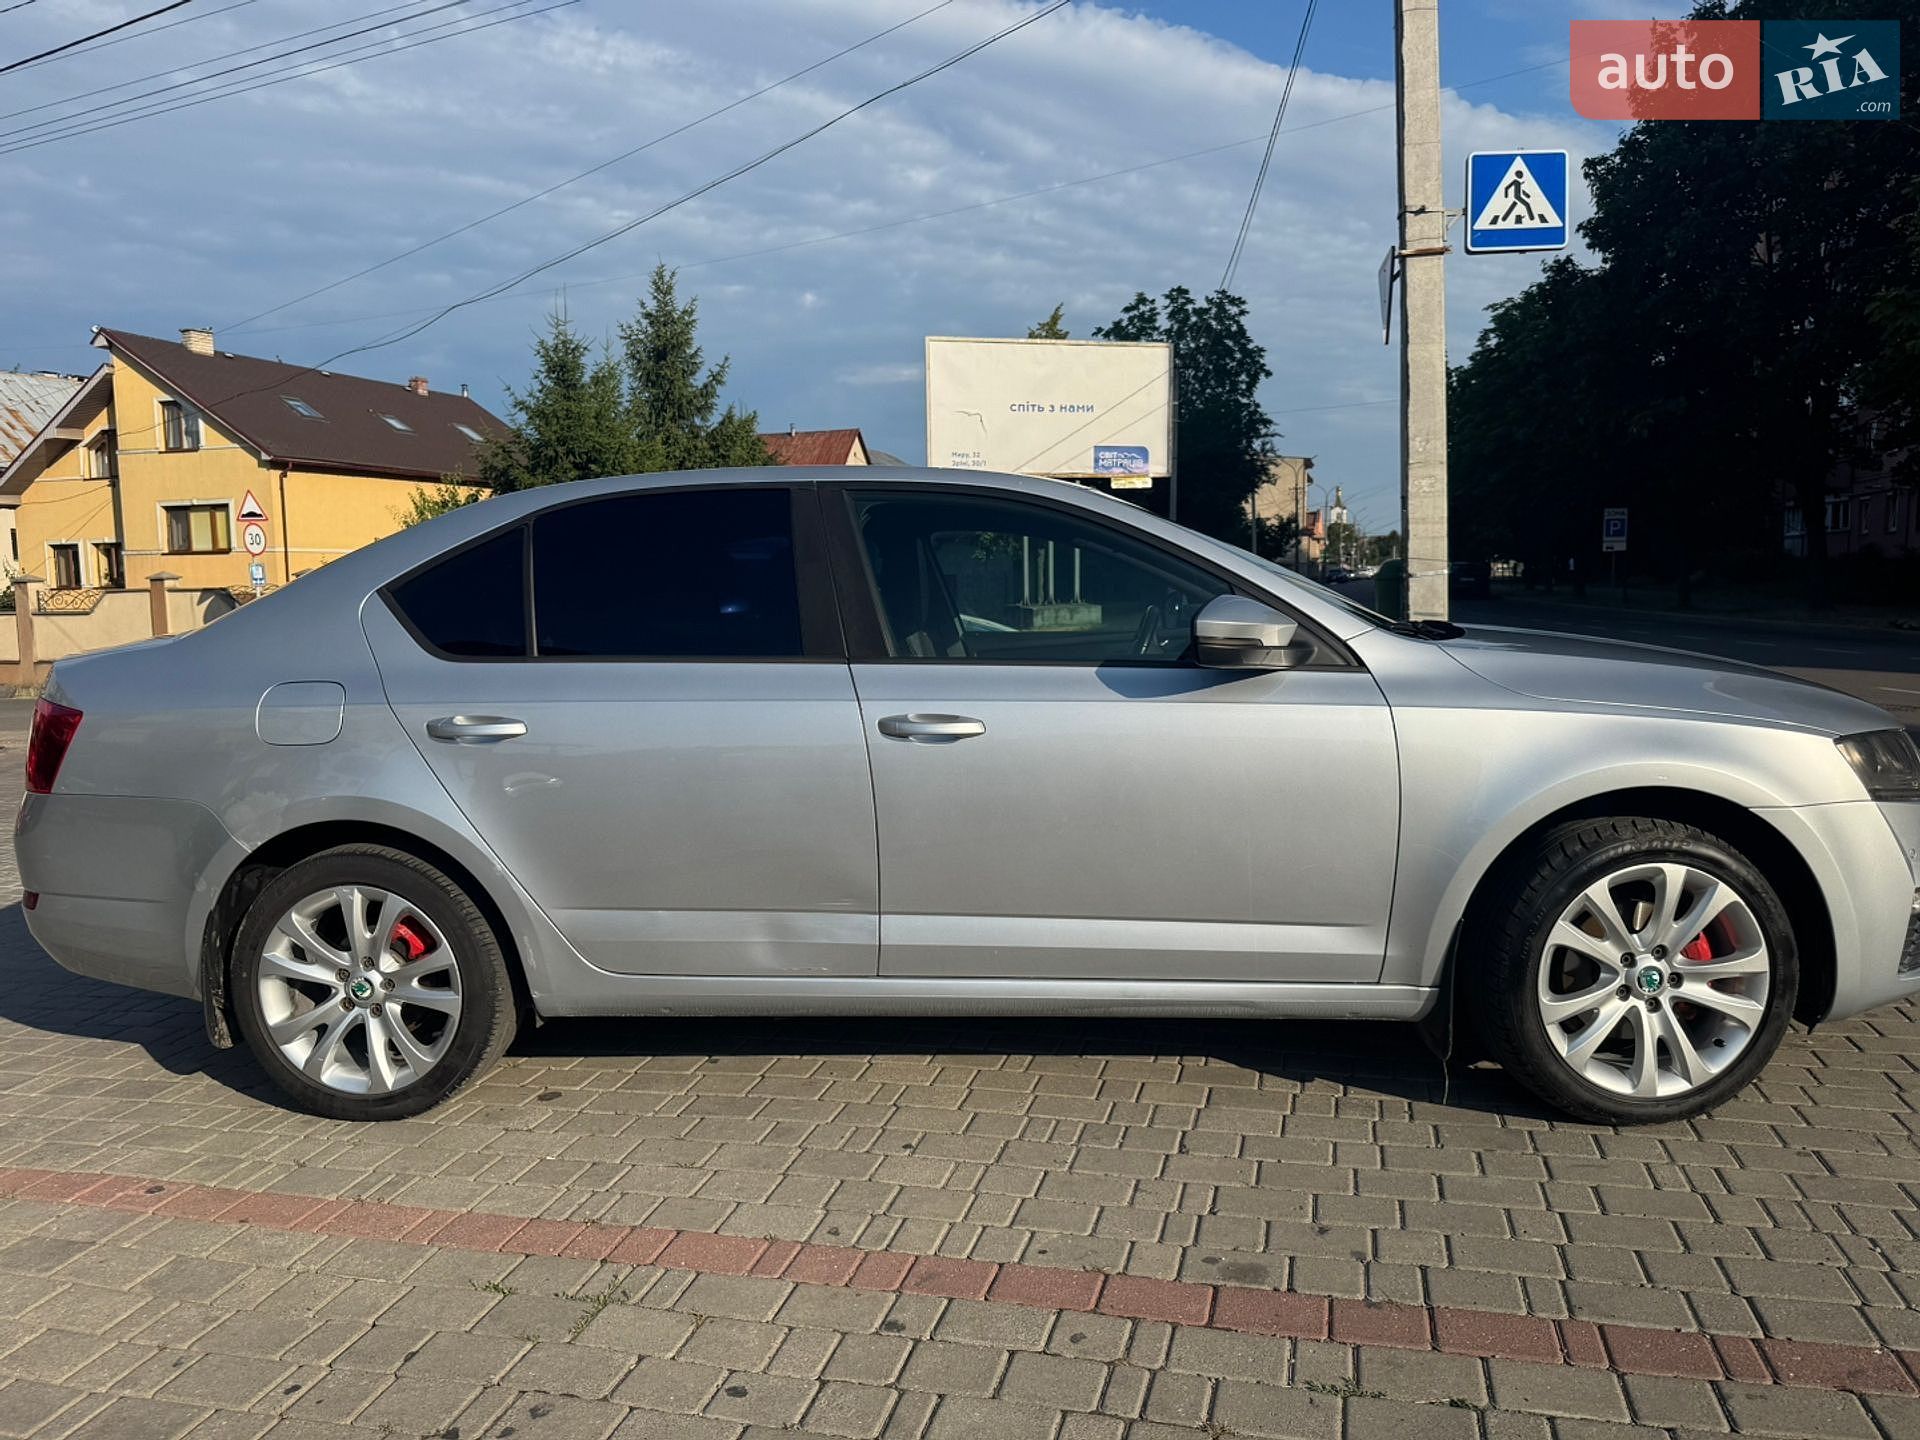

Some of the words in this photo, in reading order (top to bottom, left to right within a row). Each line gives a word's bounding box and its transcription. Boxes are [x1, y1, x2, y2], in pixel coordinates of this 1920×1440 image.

[1009, 401, 1045, 412] спіть
[1048, 404, 1056, 413] з
[1059, 404, 1095, 413] нами
[1610, 520, 1621, 536] P
[248, 533, 261, 545] 30
